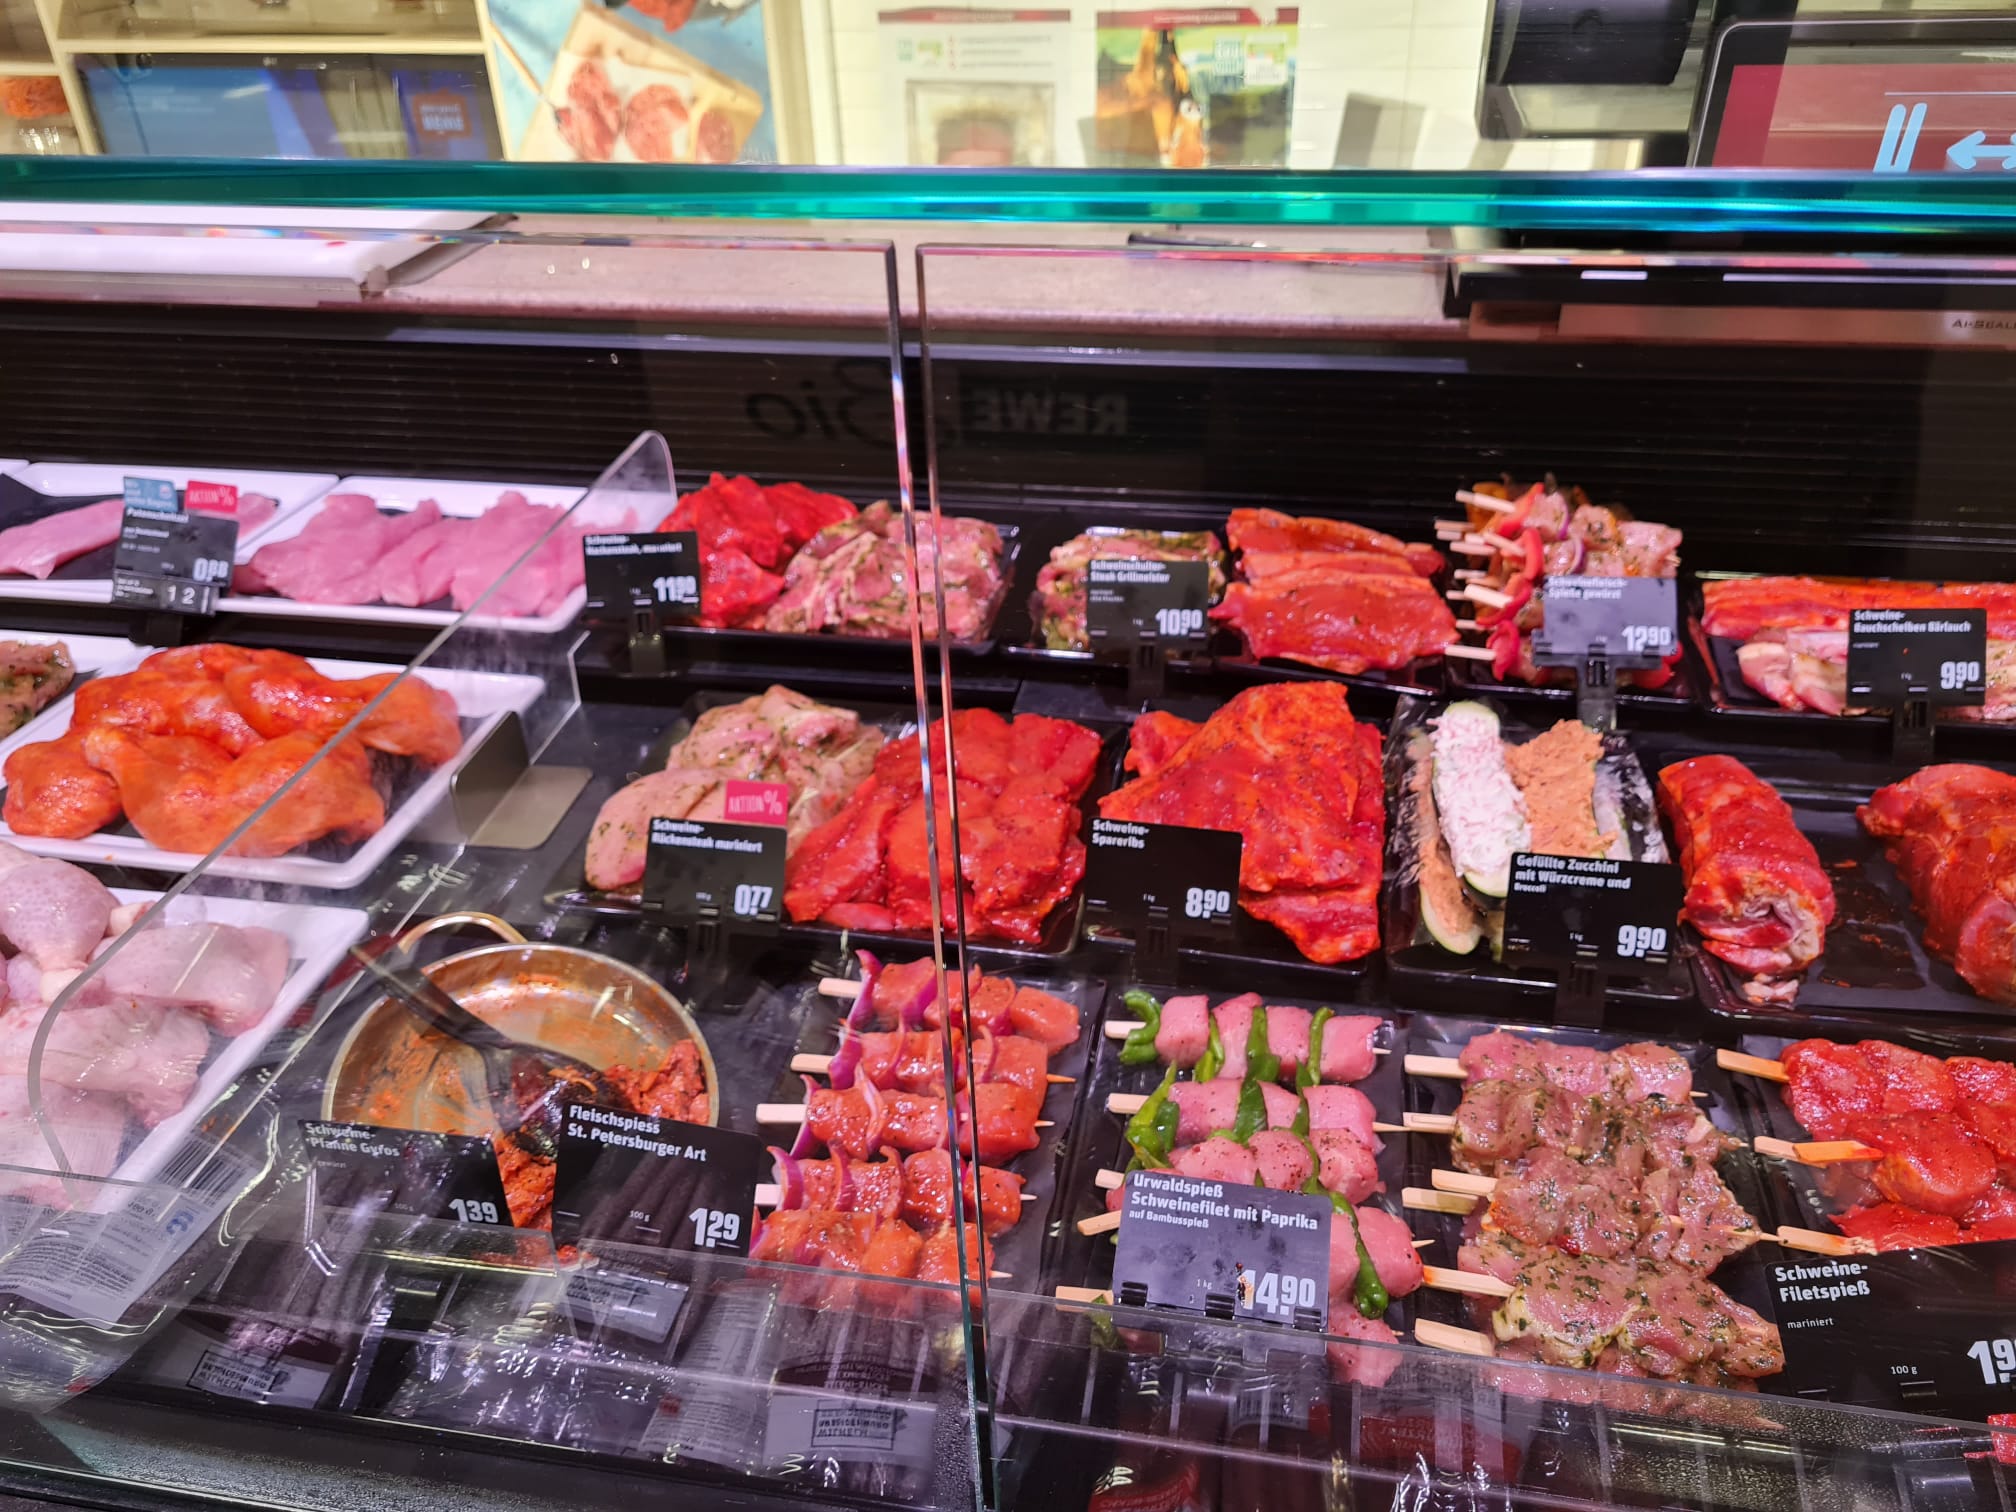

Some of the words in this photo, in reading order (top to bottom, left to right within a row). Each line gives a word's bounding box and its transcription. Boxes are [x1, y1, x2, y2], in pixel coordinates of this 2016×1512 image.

[1155, 609, 1202, 635] 10.90
[1854, 622, 1926, 633] Bauchscheiben
[1928, 621, 1971, 632] Bärlauch
[1855, 610, 1906, 621] Schweine-
[1941, 662, 1979, 689] 9.90
[1093, 820, 1149, 835] Schweine-
[1092, 833, 1145, 849] Spareribs
[1516, 855, 1565, 869] Gefüllte
[1568, 859, 1619, 873] Zucchini
[1516, 869, 1536, 881] mit
[1539, 871, 1604, 887] Würzcreme
[1607, 878, 1631, 889] und
[734, 884, 772, 915] 0.77
[1186, 888, 1230, 919] 8.90
[1617, 925, 1666, 957] 9.90
[570, 1105, 660, 1134] Fleischspiess
[568, 1123, 587, 1138] St.
[591, 1127, 682, 1157] Petersburger
[684, 1145, 706, 1161] Art
[1134, 1174, 1223, 1198] Urwaldspieß
[1129, 1210, 1145, 1219] auf
[1147, 1211, 1209, 1228] Bambusspieß
[1131, 1192, 1230, 1218] Schweinefilet
[1234, 1207, 1258, 1222] mit
[1262, 1210, 1318, 1230] Paprika
[689, 1208, 740, 1248] 1.29
[1775, 1261, 1868, 1282] Schweine-
[1238, 1269, 1315, 1316] 14.90
[1780, 1280, 1870, 1302] Filetspieß
[1787, 1318, 1834, 1329] mariniert
[1891, 1366, 1908, 1375] 100
[1912, 1366, 1917, 1375] g
[1967, 1339, 2016, 1385] 1.9
